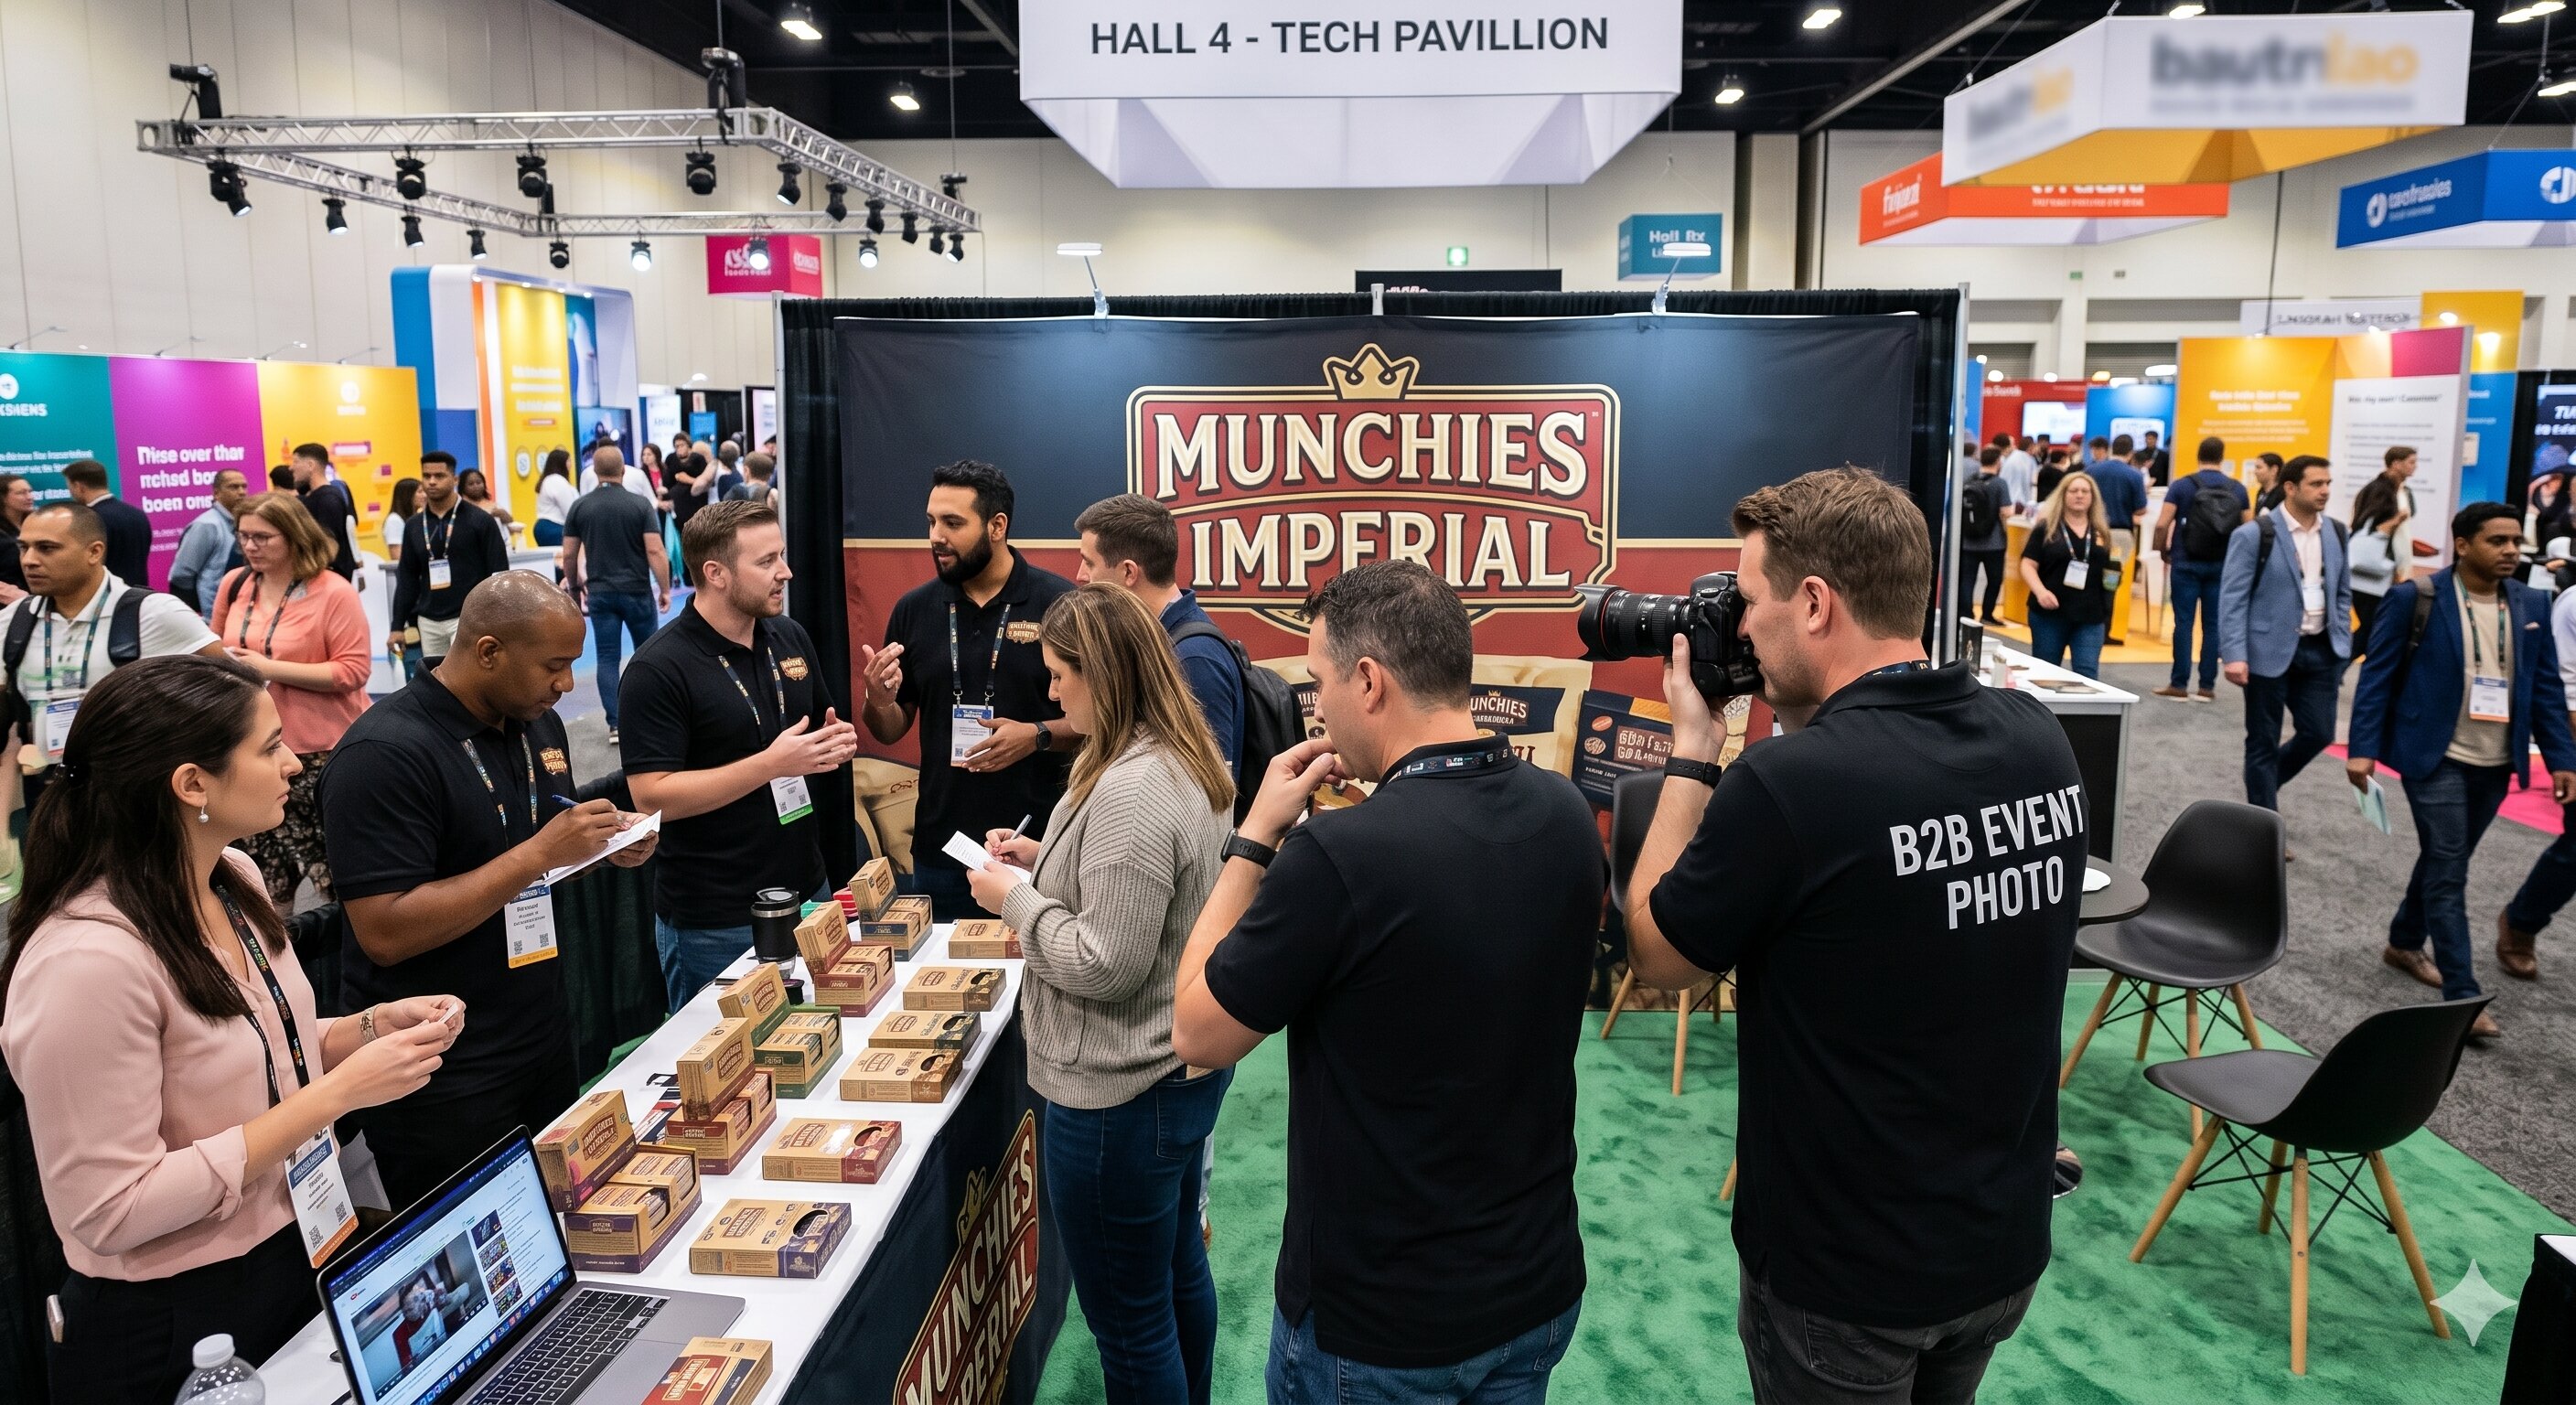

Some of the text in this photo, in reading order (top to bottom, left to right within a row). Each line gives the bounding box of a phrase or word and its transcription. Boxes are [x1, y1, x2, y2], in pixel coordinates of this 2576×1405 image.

[1091, 23, 1197, 56] HALL
[1208, 22, 1232, 55] 4
[1272, 21, 1380, 53] TECH
[1394, 16, 1609, 52] PAVILLION
[179, 447, 211, 463] over
[1154, 411, 1588, 500] MUNCHIES
[1191, 510, 1571, 588] IMPERIAL
[1470, 697, 1527, 719] UNCHIES
[1889, 784, 2084, 876] B2B EVENT
[1947, 855, 2064, 929] PHOTO
[905, 1134, 1033, 1405] MUNCHIES
[954, 1241, 1033, 1405] PERIAL
